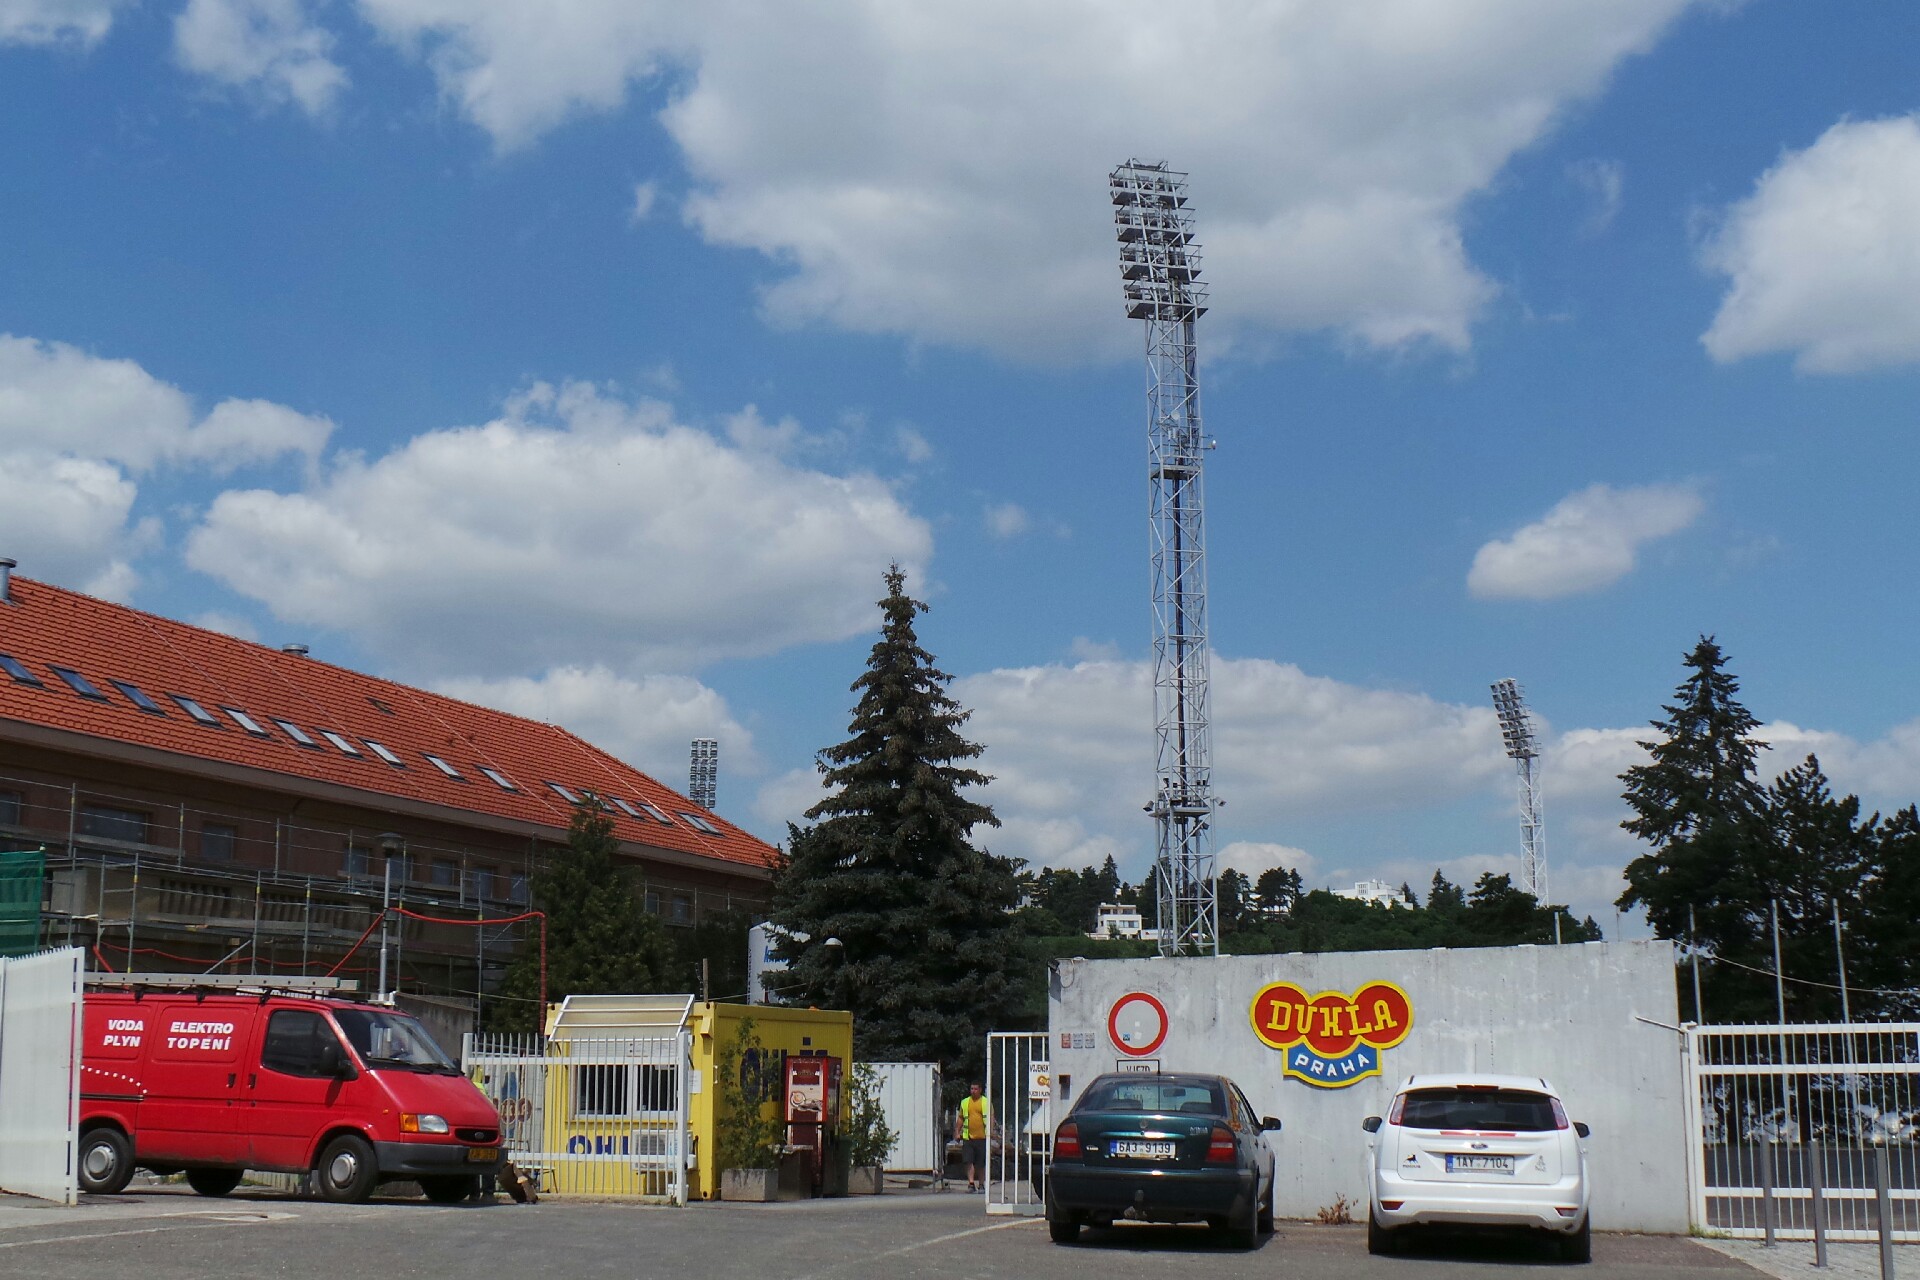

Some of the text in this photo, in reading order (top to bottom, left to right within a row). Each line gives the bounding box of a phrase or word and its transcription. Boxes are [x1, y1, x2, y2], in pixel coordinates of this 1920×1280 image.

[1266, 999, 1398, 1037] DUKLA
[107, 1019, 144, 1031] VODA
[170, 1021, 234, 1034] ELEKTRO
[103, 1035, 141, 1047] PLYN
[167, 1036, 232, 1051] TOPENÍ
[1294, 1053, 1370, 1077] PRAHA
[1118, 1142, 1171, 1154] 6A3 9139
[1456, 1156, 1509, 1169] 1AY 7104
